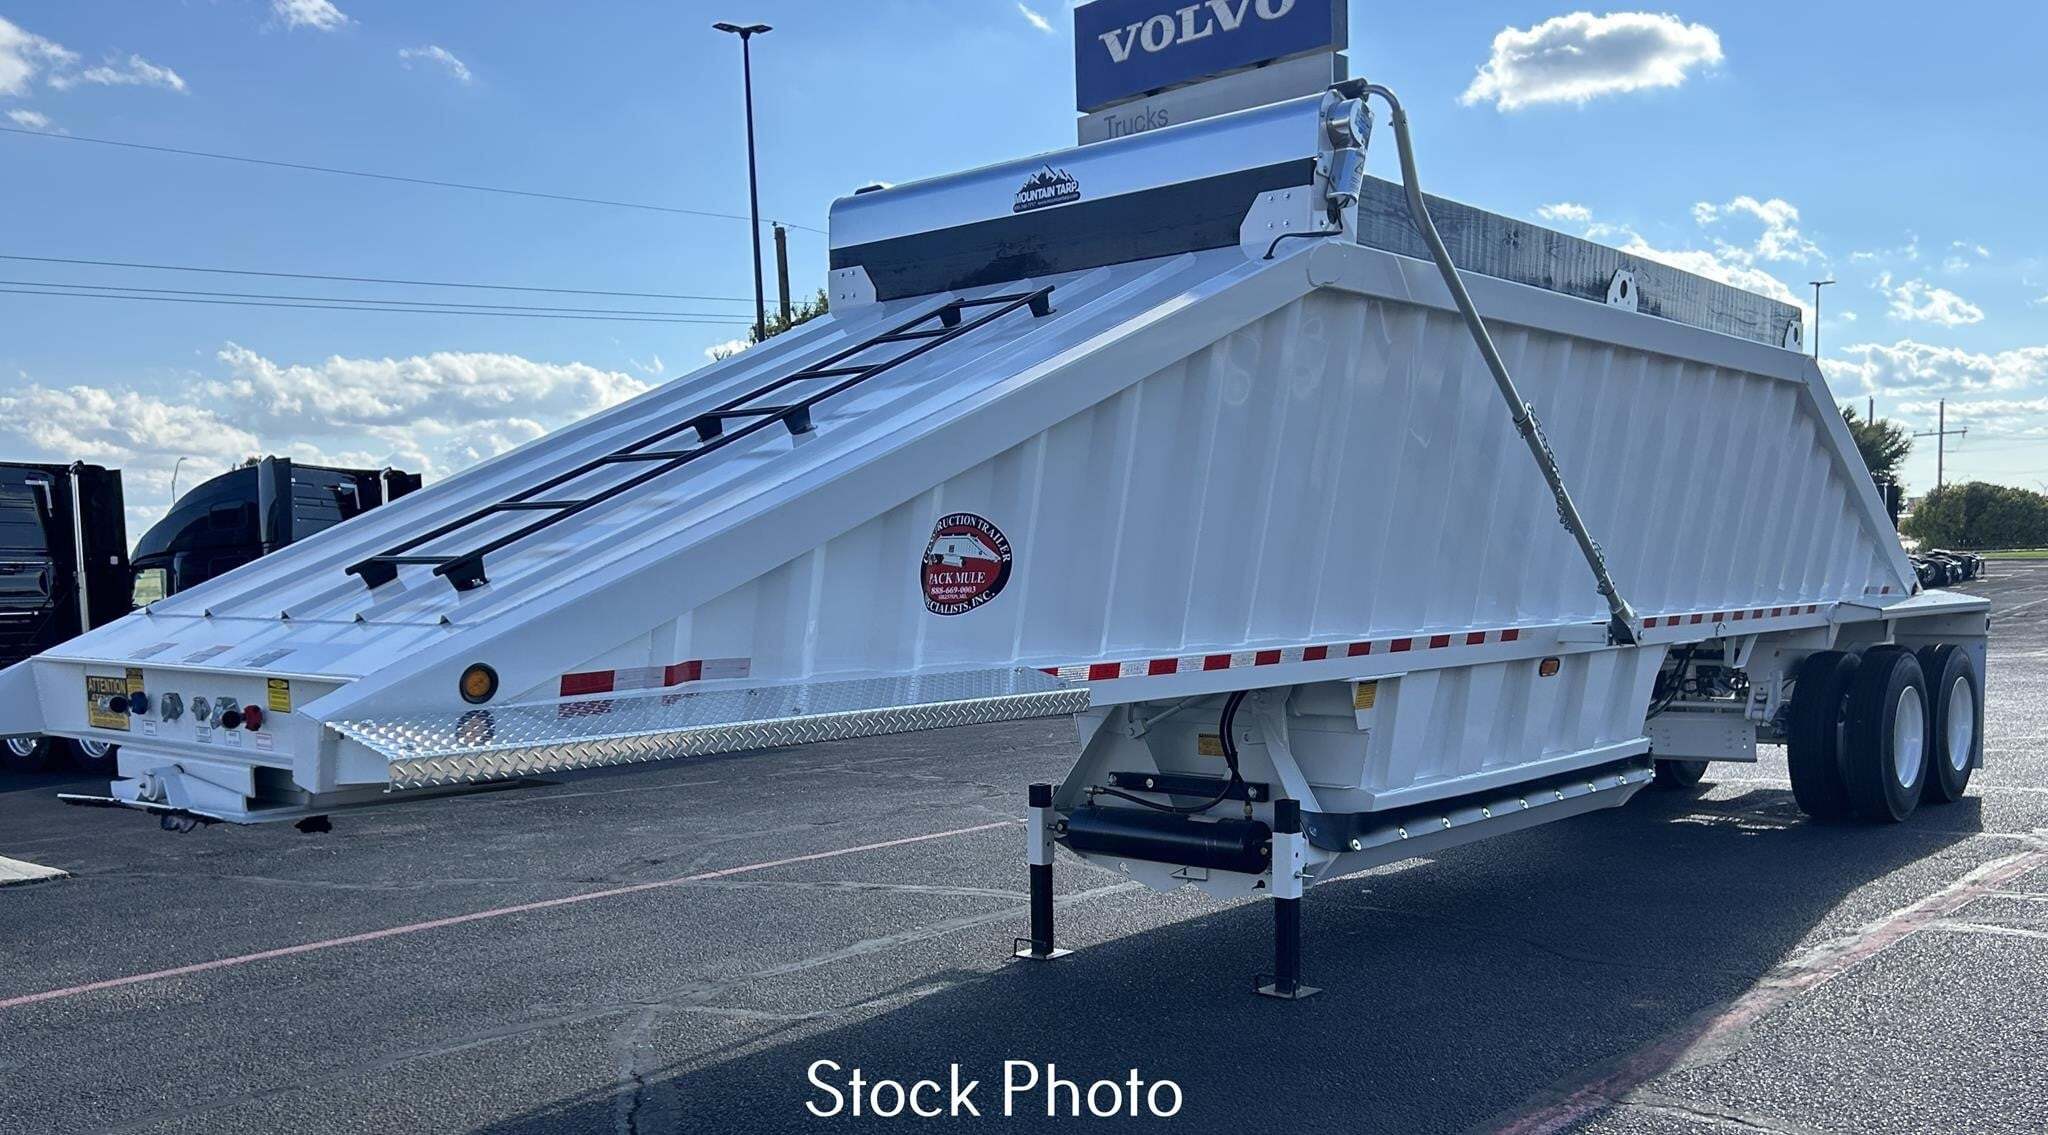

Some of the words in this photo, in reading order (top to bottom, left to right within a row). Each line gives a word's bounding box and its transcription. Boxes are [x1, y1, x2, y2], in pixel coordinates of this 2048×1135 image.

[1098, 0, 1296, 63] VOLVO
[1103, 106, 1169, 139] Trucks
[1015, 185, 1056, 204] MOUNTAIN
[1056, 181, 1078, 195] TARP
[977, 519, 1011, 563] TRAILER
[956, 571, 986, 584] MULE
[971, 590, 996, 608] INC.
[88, 678, 127, 694] ATTENTION
